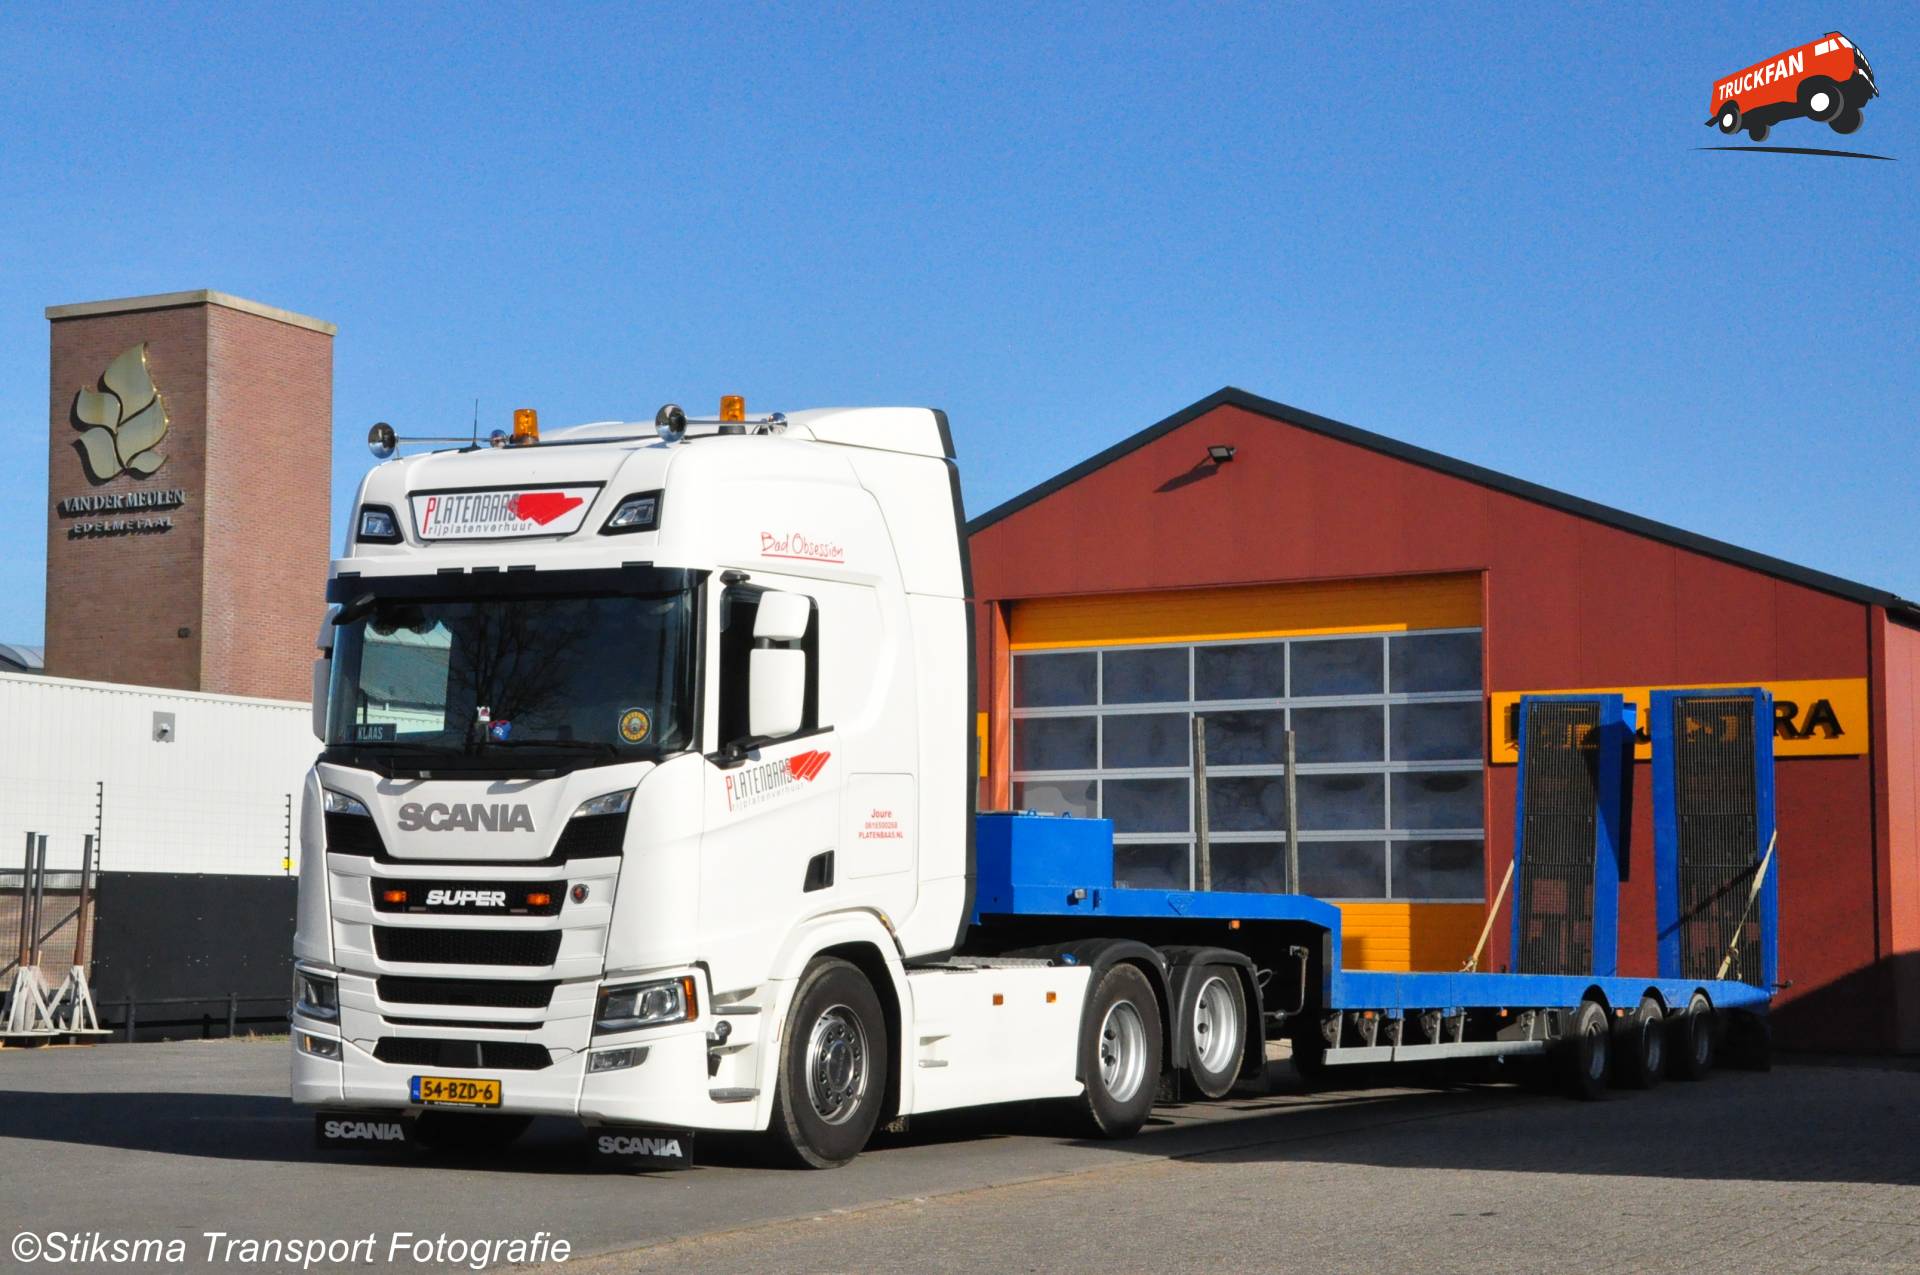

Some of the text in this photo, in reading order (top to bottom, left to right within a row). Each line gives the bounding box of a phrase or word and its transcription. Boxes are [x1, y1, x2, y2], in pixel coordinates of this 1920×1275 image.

[63, 489, 186, 512] VAN DER MEULEN
[73, 516, 174, 533] EDELMETAAL
[422, 493, 519, 534] PLATENBAAS
[428, 522, 532, 536] rijplatenverhuur
[760, 531, 844, 557] Bad Obsession
[357, 726, 383, 740] KLAAS
[725, 758, 793, 812] PLATENBAAS
[397, 802, 535, 832] SCANIA
[871, 808, 892, 818] Joure
[426, 889, 507, 907] SUPER
[423, 1080, 493, 1100] 54-BZD-6
[324, 1120, 405, 1142] SCANIA
[598, 1135, 683, 1159] SCANIA
